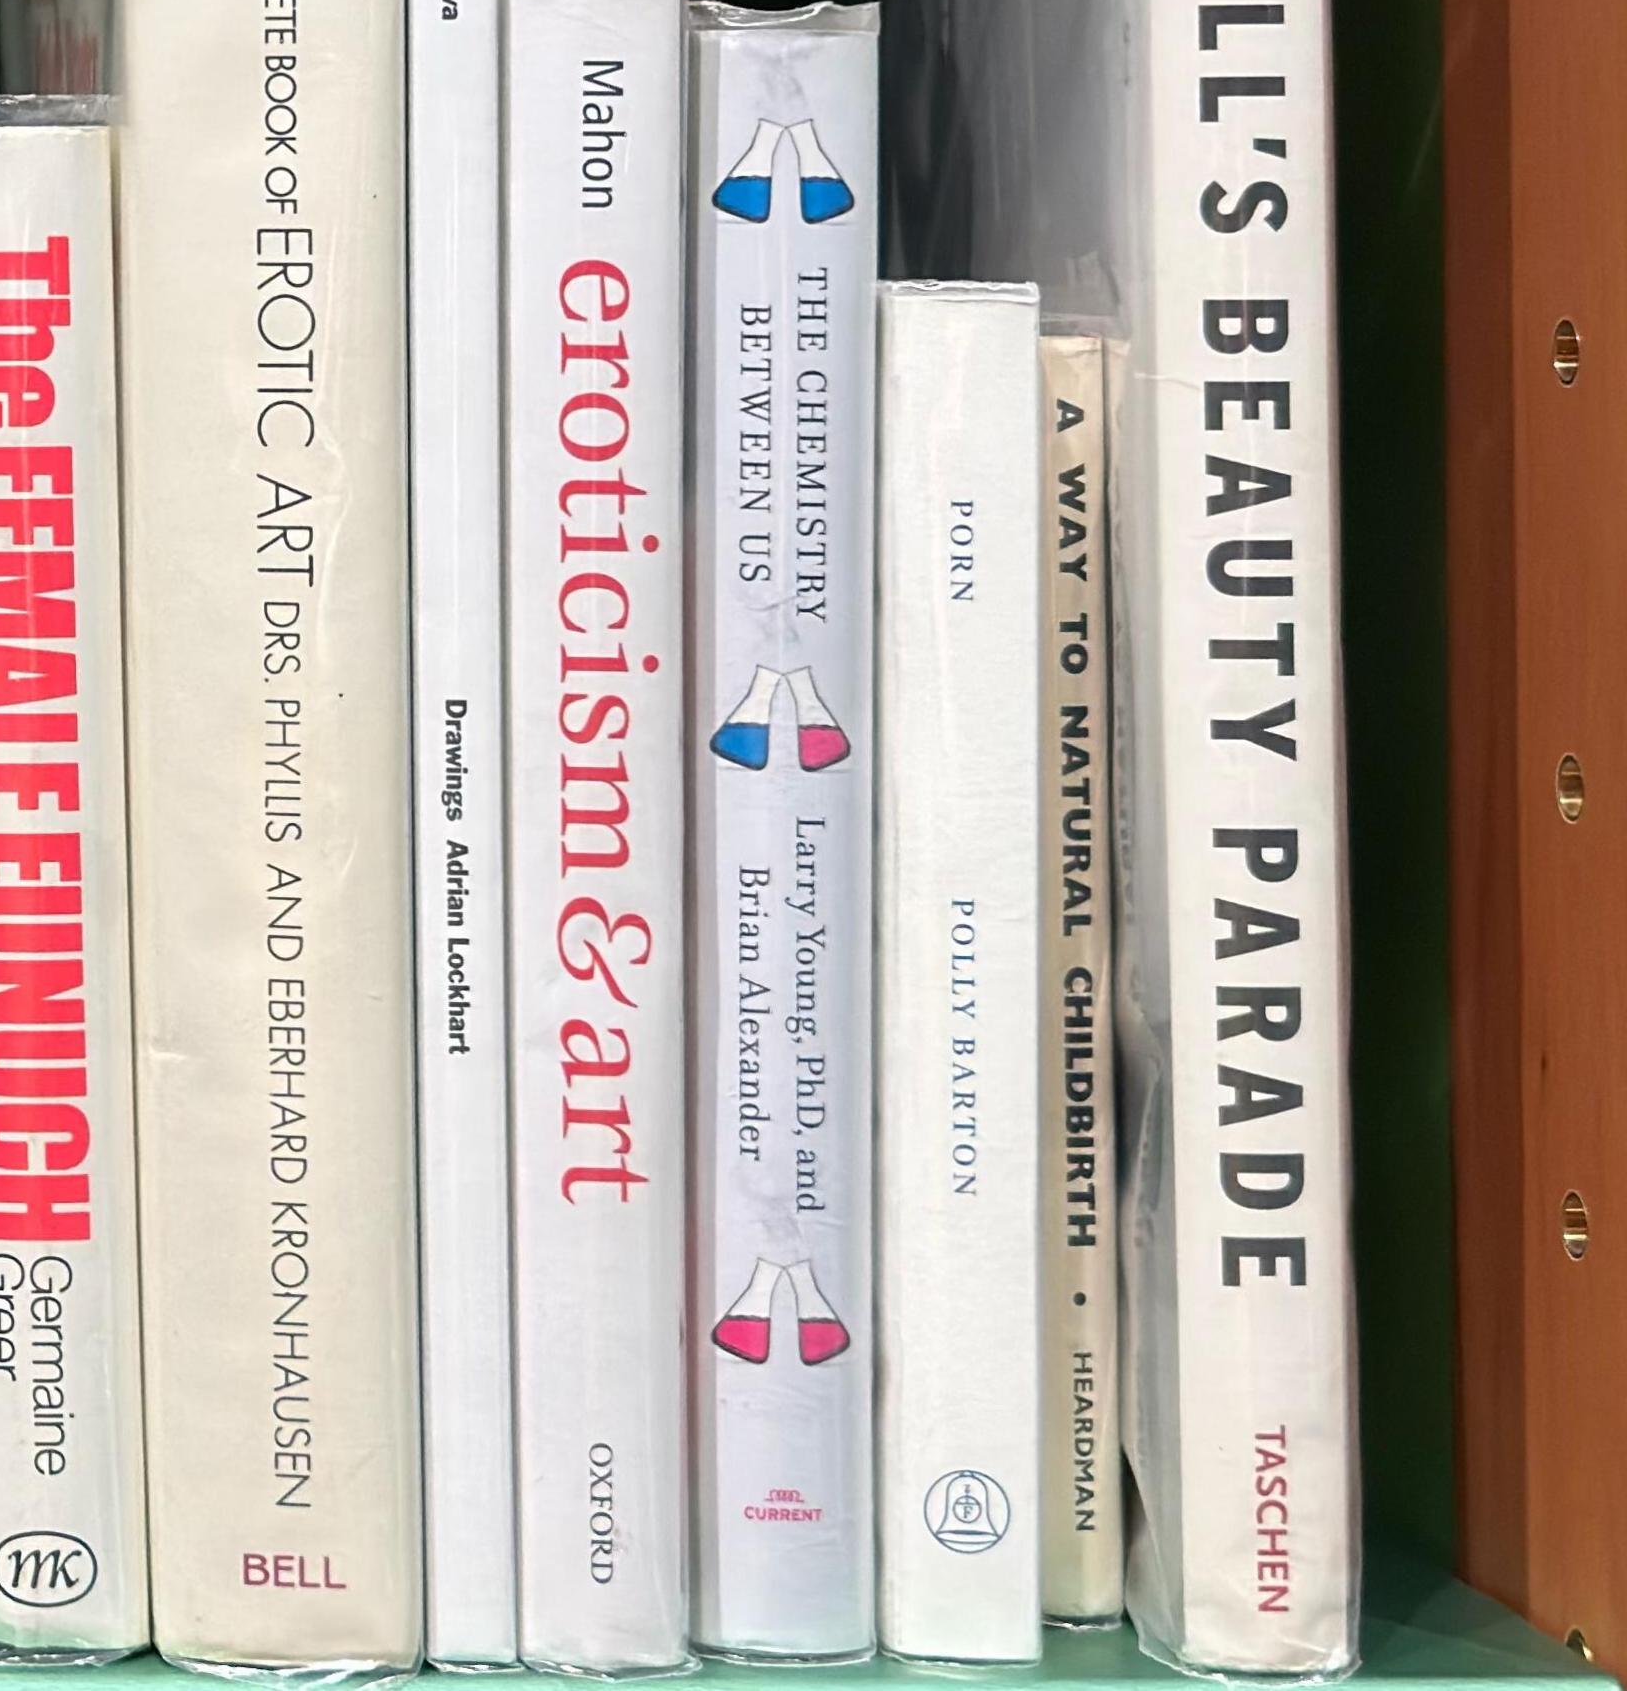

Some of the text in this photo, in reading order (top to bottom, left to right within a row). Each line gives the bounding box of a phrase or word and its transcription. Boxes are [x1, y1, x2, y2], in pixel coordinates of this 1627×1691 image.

[265, 56, 297, 155] BOOK
[265, 167, 297, 214] OF
[257, 229, 315, 447] EROTIC
[739, 305, 771, 581] BETWEEN US
[257, 474, 313, 587] ART
[796, 268, 827, 622] THE CHEMISTRY
[951, 501, 973, 600] PORN
[1203, 299, 1297, 761] BEAUTY
[264, 602, 301, 682] DRS.
[558, 61, 659, 1204] Mahon eroticism & art
[265, 700, 302, 842] PHYLLIS
[267, 864, 303, 961] AND
[441, 700, 470, 1054] Drawings Adrian Lockhart
[269, 979, 307, 1183] EBERHARD
[739, 867, 771, 1161] Brian Alexander
[785, 818, 825, 1212] Larry Young, PhD, and
[952, 901, 976, 1194] POLLY BARTON
[1213, 829, 1306, 1286] PARADE
[30, 1256, 74, 1475] Germaine
[271, 1202, 311, 1507] KRONHAUSEN
[244, 1554, 346, 1589] BELL
[590, 1443, 613, 1584] OXFORD
[745, 1507, 822, 1521] CURRENT
[1255, 1425, 1289, 1612] TASCHEN
